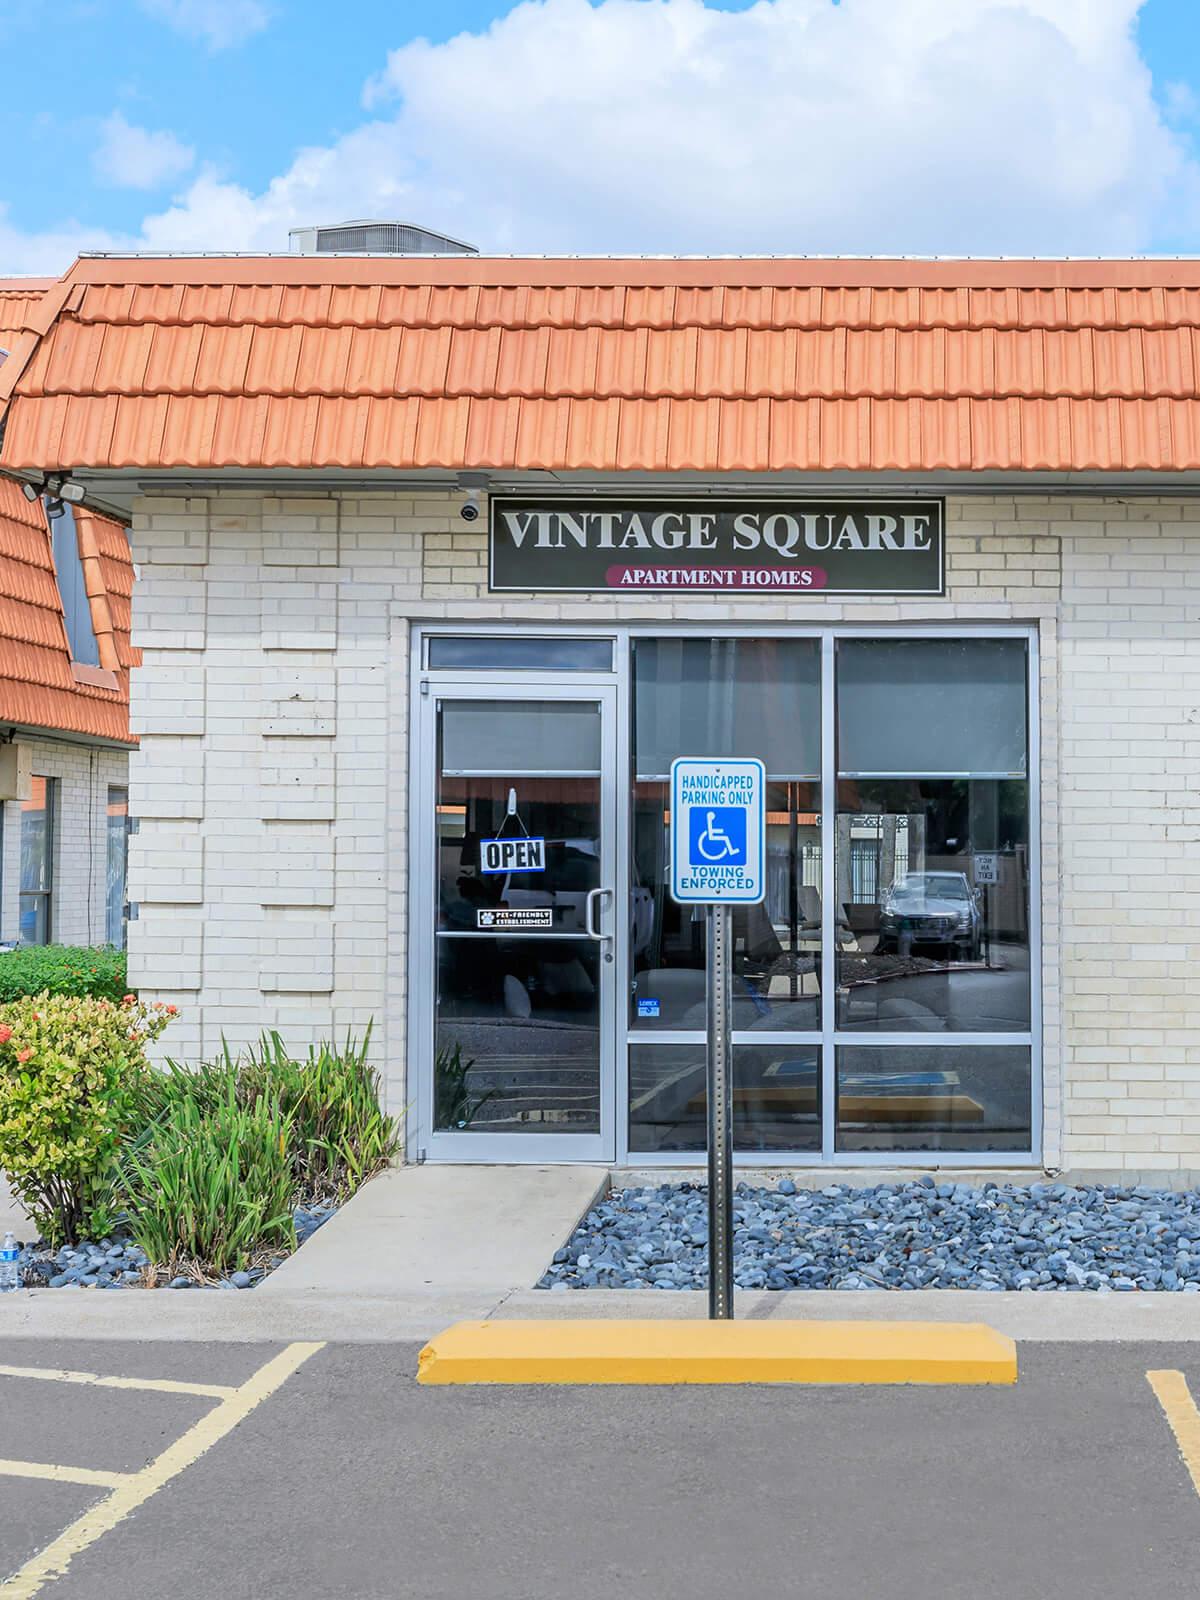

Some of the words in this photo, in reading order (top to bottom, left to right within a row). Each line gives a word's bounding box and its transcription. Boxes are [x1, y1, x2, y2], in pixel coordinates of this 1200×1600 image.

[502, 512, 719, 550] VINTAGE
[732, 513, 932, 558] SQUARE
[620, 569, 737, 585] APARTMENT
[741, 569, 813, 585] HOMES
[682, 775, 754, 789] HANDICAPPED
[681, 791, 726, 805] PARKING
[728, 791, 754, 805] ONLY
[486, 841, 542, 870] OPEN
[690, 866, 744, 878] TOWING
[681, 878, 755, 889] ENFORCED
